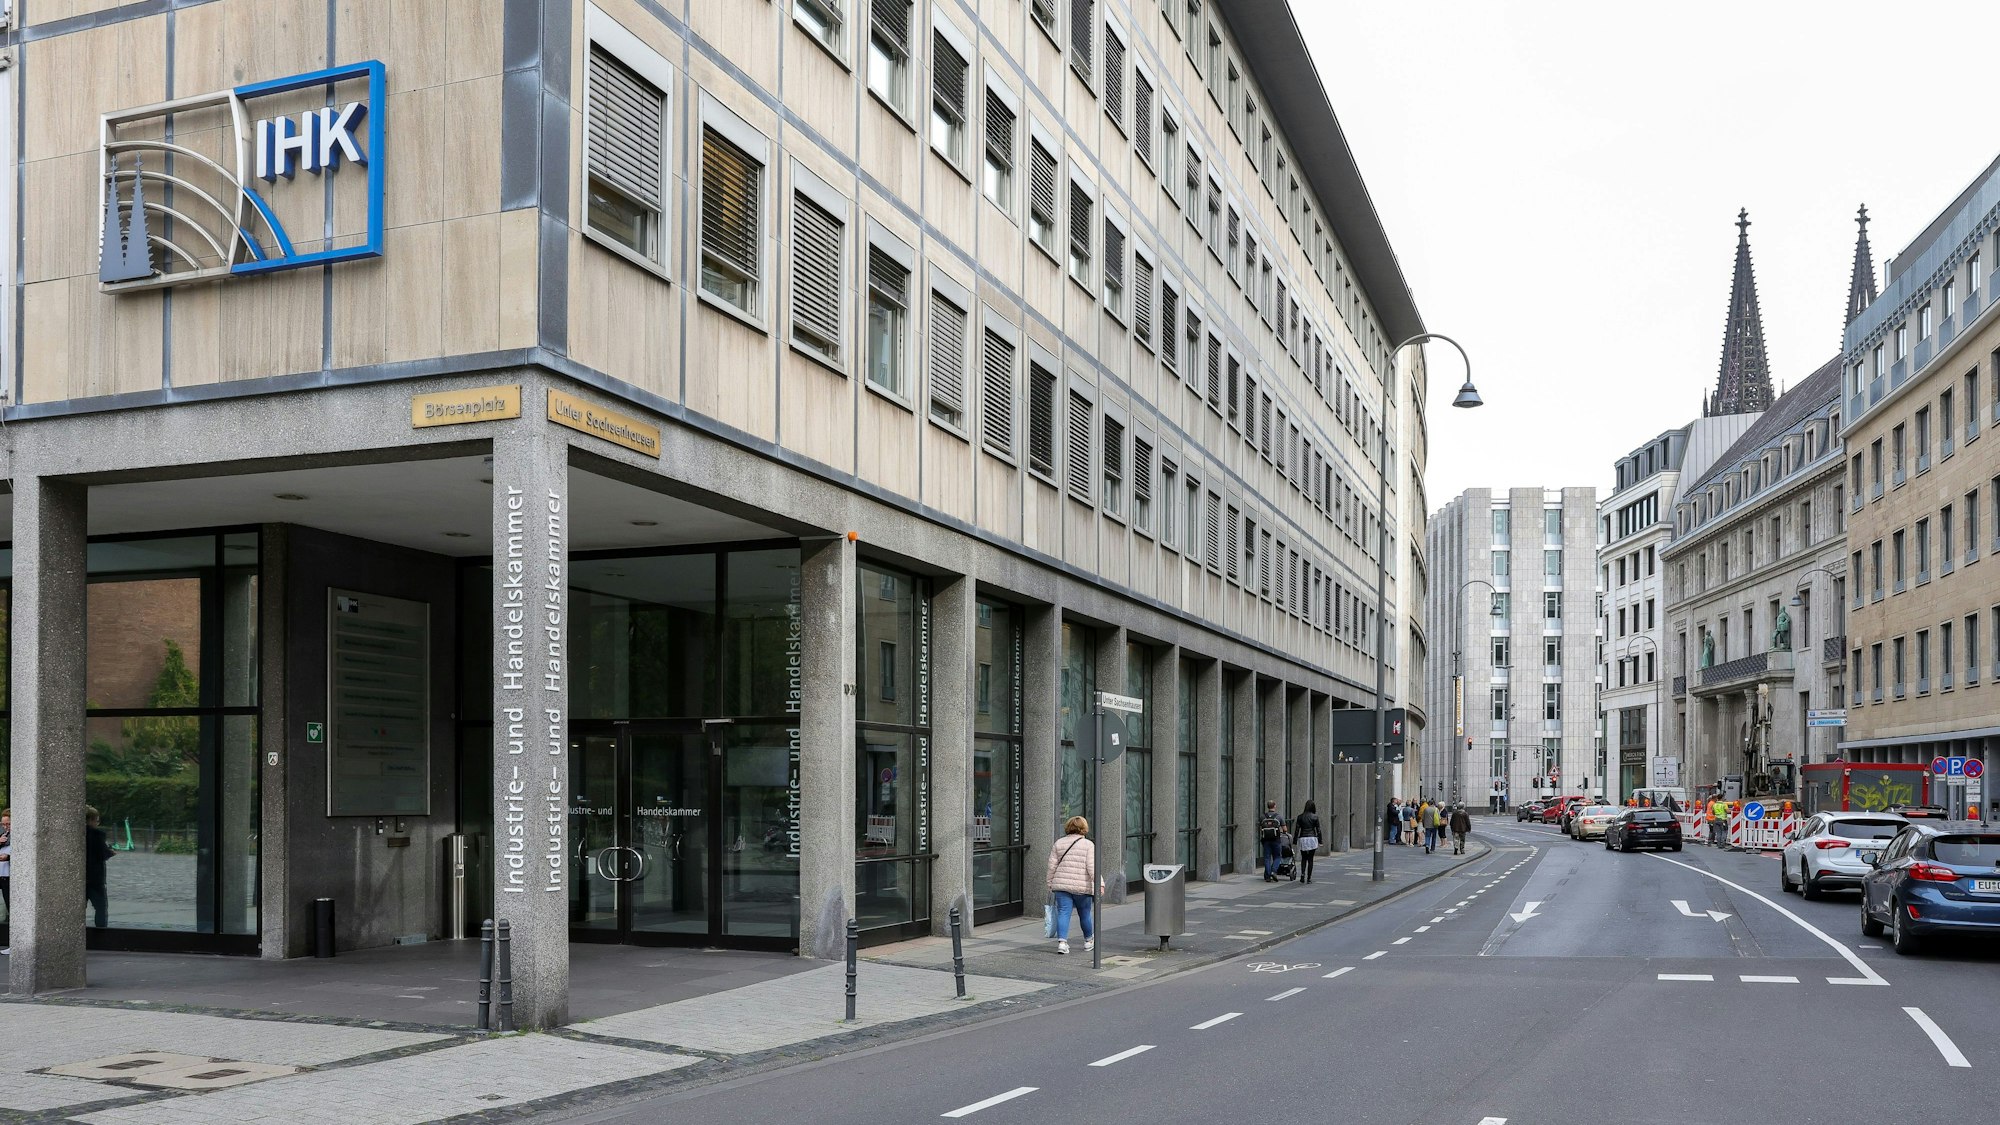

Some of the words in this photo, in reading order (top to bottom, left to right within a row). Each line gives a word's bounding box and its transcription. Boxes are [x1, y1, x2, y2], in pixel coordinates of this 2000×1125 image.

[256, 102, 366, 181] IHK
[425, 397, 505, 418] Börsenplatz
[555, 398, 583, 422] Unter
[586, 410, 656, 449] Sachsenhausen
[503, 486, 523, 690] Handelskammer
[545, 488, 561, 691] Handelskammer
[785, 571, 801, 713] Handelskammer
[919, 599, 929, 725] Handelskammer
[1013, 624, 1021, 733] Handelskammer
[504, 708, 524, 755] und
[546, 709, 561, 755] und
[785, 728, 801, 762] und
[919, 737, 928, 767] und
[1951, 759, 1962, 774] P
[504, 766, 524, 892] Industrie-
[546, 767, 561, 892] Industrie-
[598, 806, 613, 816] und
[637, 806, 702, 817] Handelskammer
[785, 769, 801, 858] Industrie-
[919, 773, 928, 851] Industrie-
